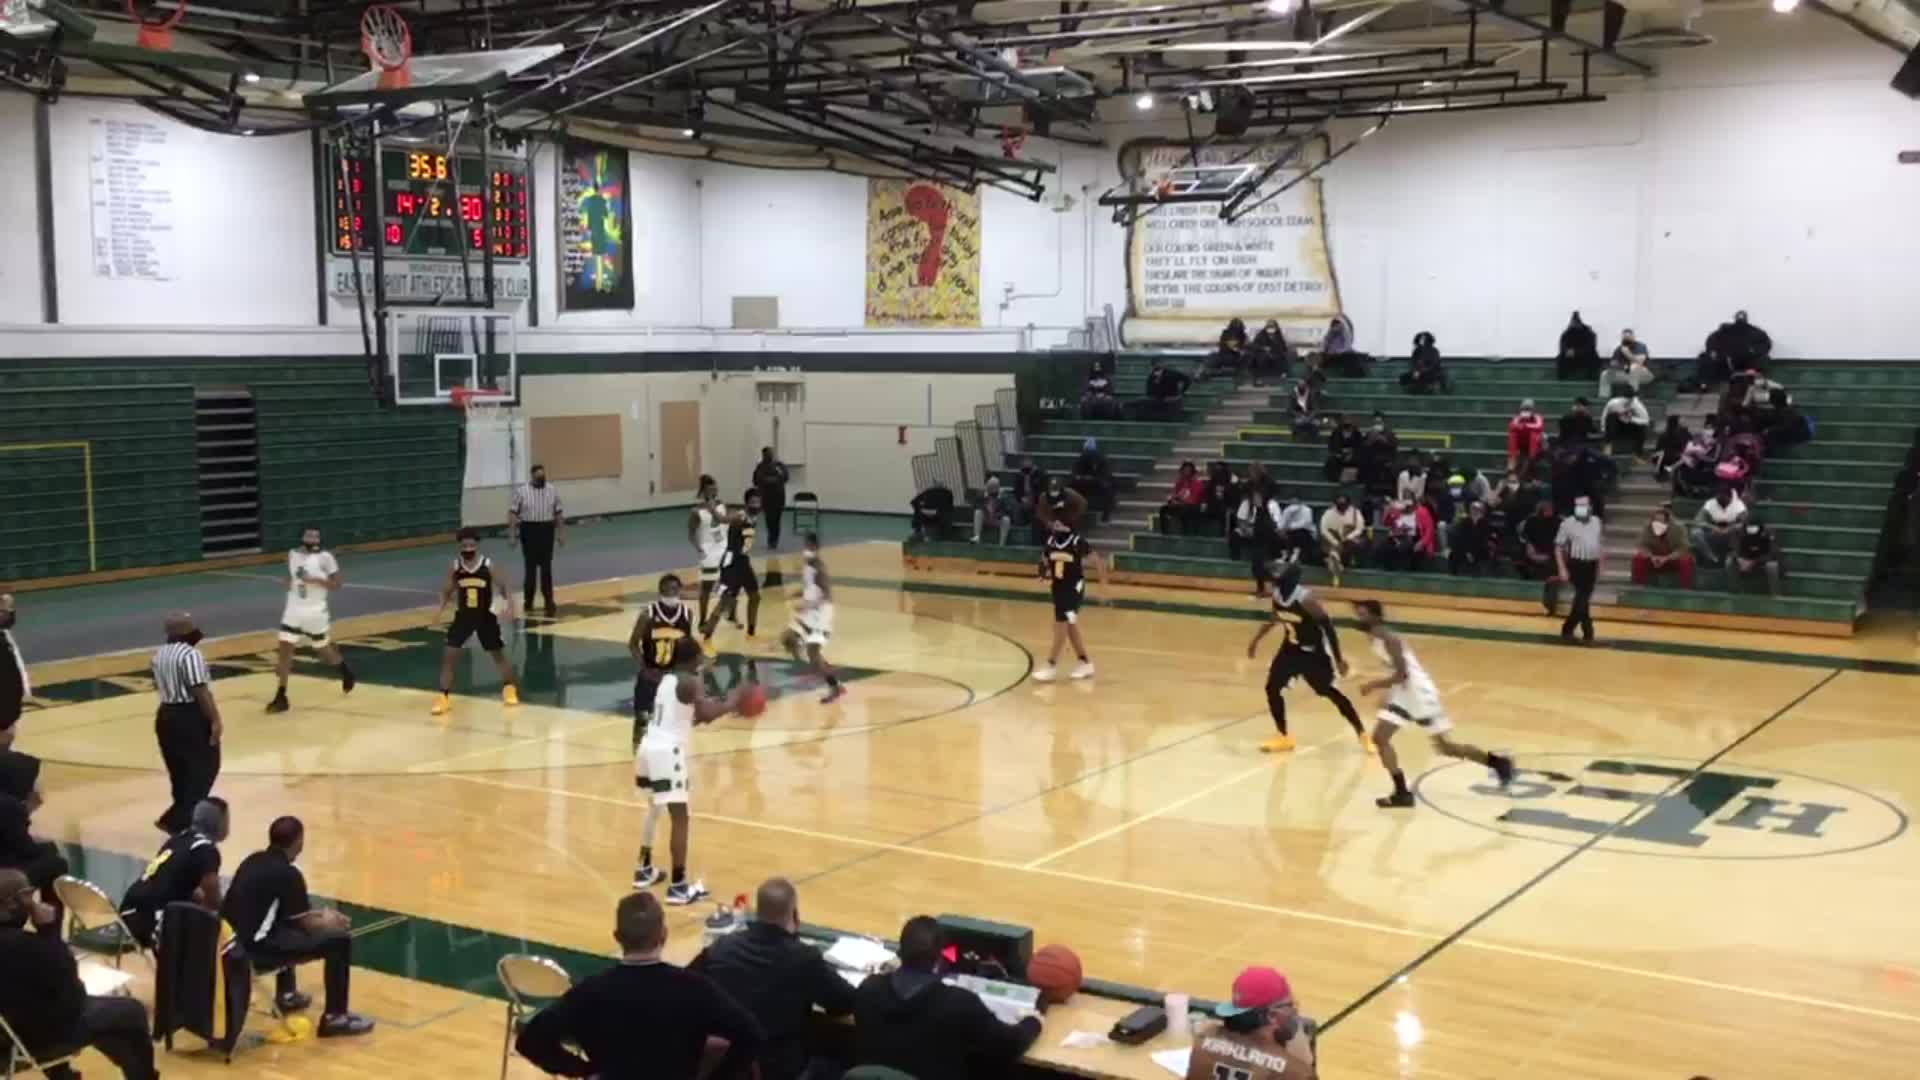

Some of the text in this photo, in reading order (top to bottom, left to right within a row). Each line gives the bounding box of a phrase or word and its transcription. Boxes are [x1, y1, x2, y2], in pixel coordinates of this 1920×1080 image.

[396, 193, 414, 214] 14
[431, 198, 439, 215] 2
[460, 198, 482, 220] 30
[386, 224, 401, 244] 10
[473, 228, 482, 247] 5
[1189, 255, 1207, 265] FLY
[1211, 255, 1228, 265] ON
[1184, 283, 1202, 294] THE
[1204, 282, 1240, 293] COLORS
[1258, 281, 1281, 292] EAST
[1202, 1036, 1287, 1074] KIRKLAND
